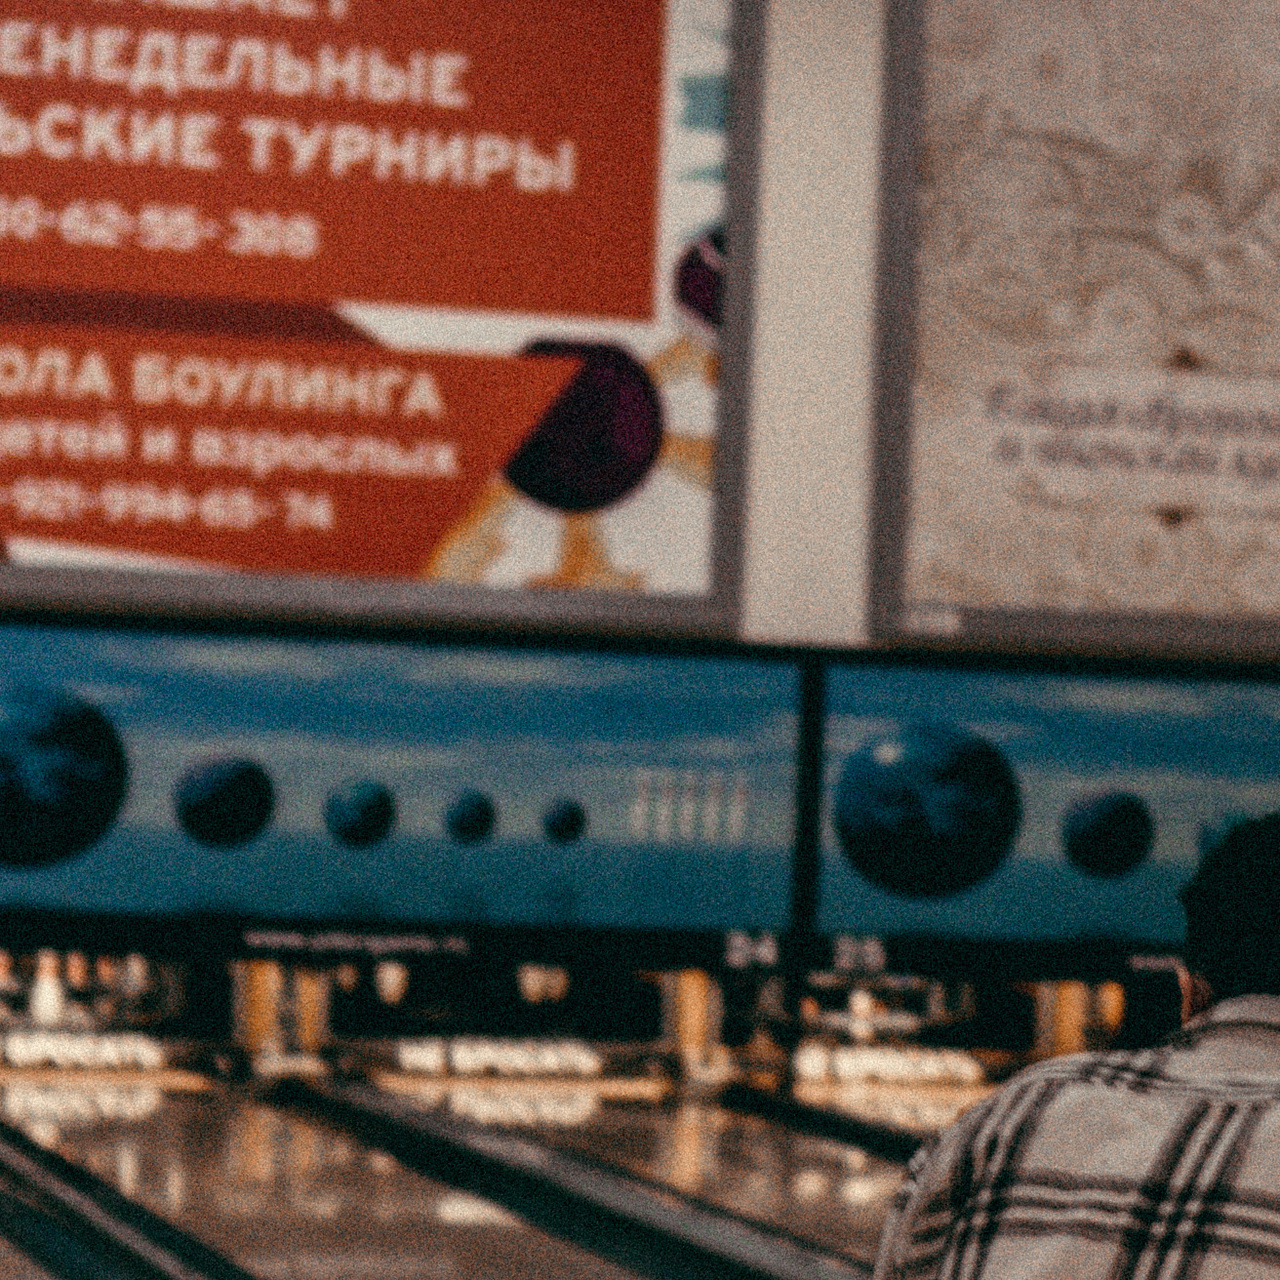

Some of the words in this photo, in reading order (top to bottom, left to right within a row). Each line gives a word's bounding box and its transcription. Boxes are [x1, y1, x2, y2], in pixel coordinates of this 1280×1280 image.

[239, 117, 577, 196] ТУРНИРЫ
[131, 354, 446, 419] БОУЛИНГА
[140, 427, 180, 464] и
[191, 430, 460, 481] взрослых
